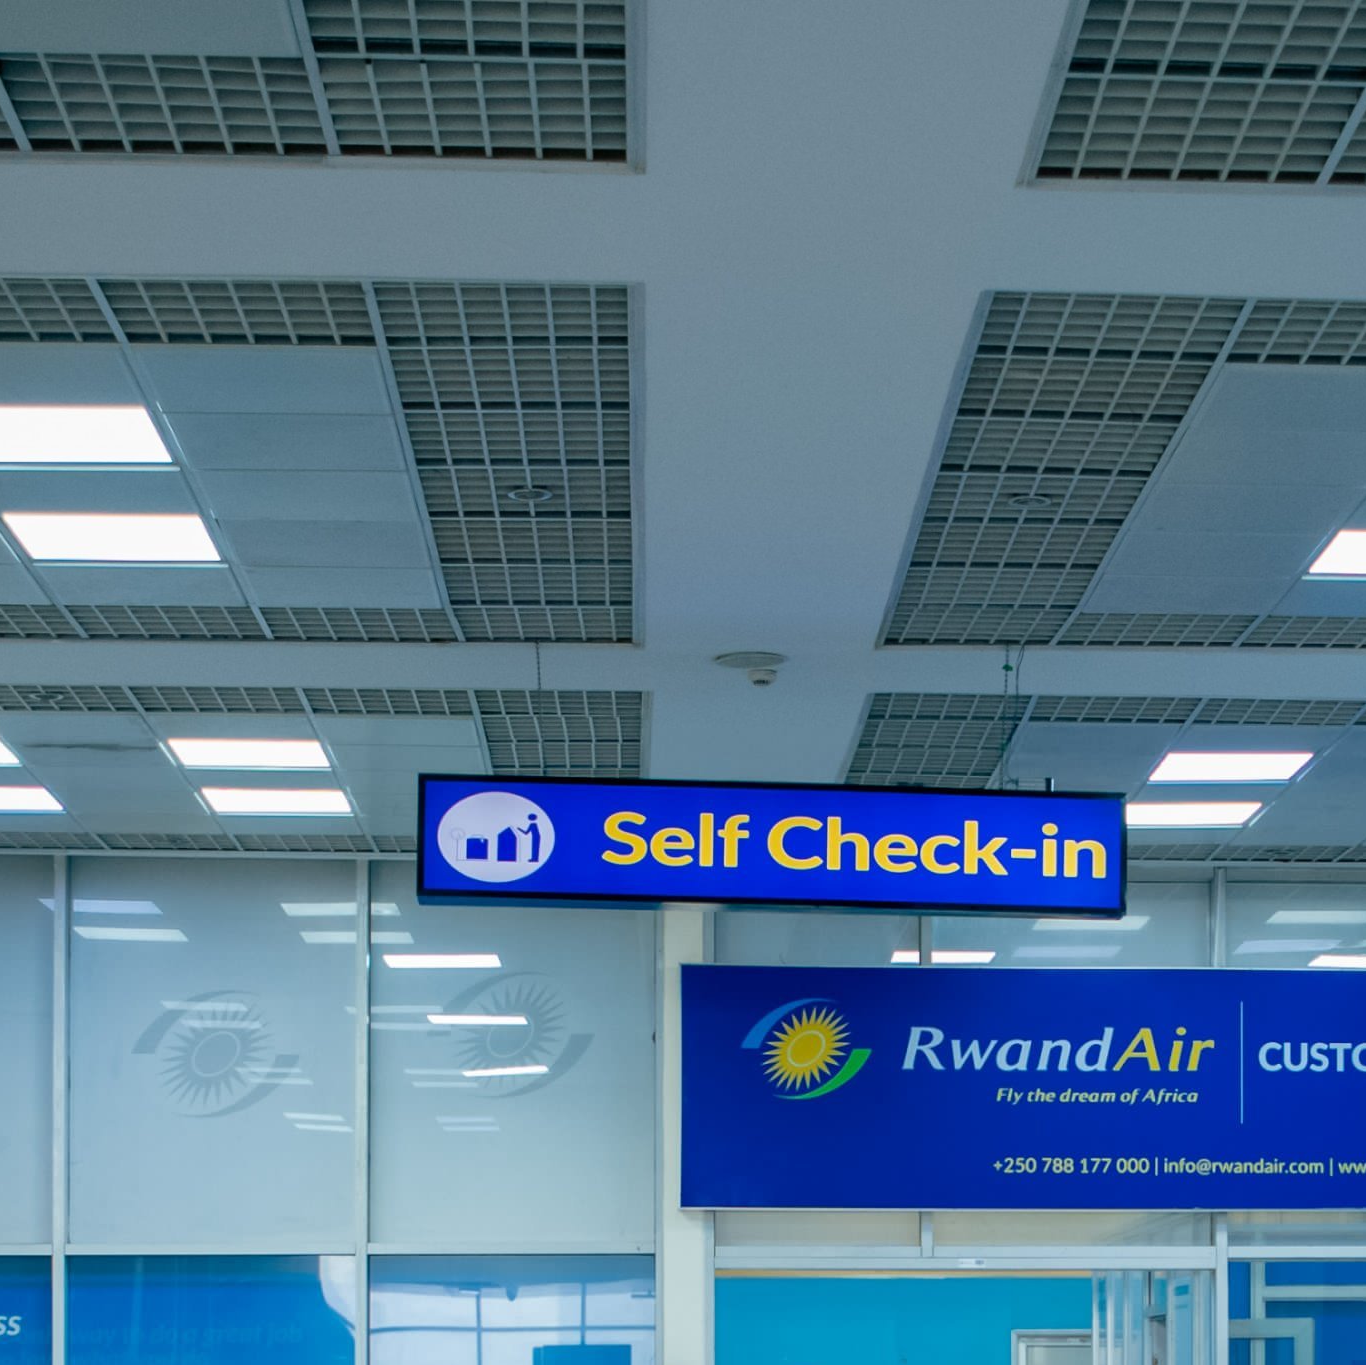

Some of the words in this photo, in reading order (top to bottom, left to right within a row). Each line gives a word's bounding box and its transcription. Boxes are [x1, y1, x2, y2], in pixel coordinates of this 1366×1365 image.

[601, 811, 751, 867] Self
[767, 815, 1108, 879] Check-in
[901, 1026, 1216, 1072] RwandAir
[996, 1087, 1022, 1106] Fly
[1026, 1087, 1056, 1103] the
[1059, 1087, 1116, 1103] dream
[1120, 1088, 1141, 1105] of
[1141, 1088, 1199, 1105] Africa
[992, 1157, 1037, 1174] +250
[1041, 1157, 1075, 1174] 788
[1080, 1157, 1113, 1174] 177
[1116, 1157, 1150, 1174] 000
[1163, 1158, 1325, 1176] info@rwandair.com
